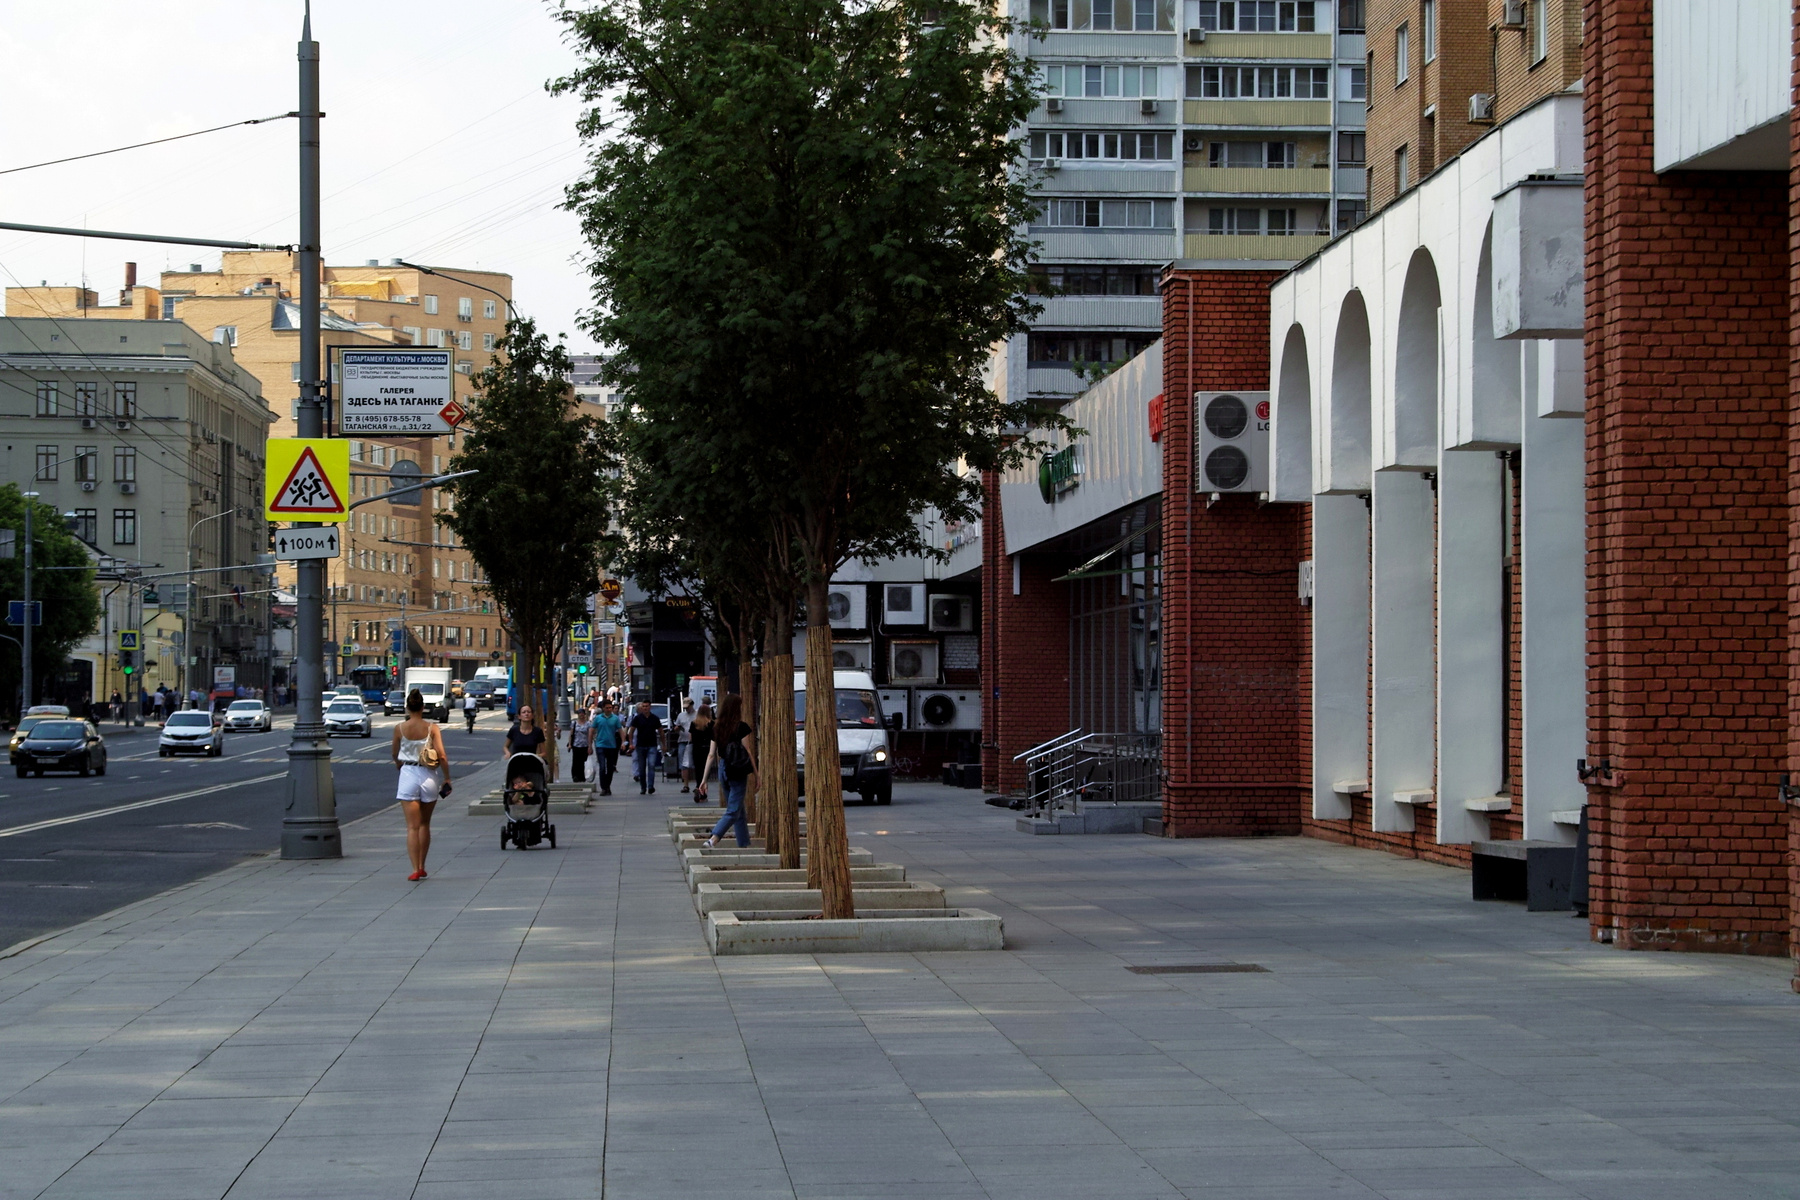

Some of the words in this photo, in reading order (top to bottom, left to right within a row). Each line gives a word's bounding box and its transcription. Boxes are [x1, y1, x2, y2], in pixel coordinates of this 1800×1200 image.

[347, 397, 382, 407] ЗДЕСЬ
[384, 397, 398, 406] НА
[400, 397, 444, 406] ТАГАНКЕ
[362, 415, 382, 423] (495)
